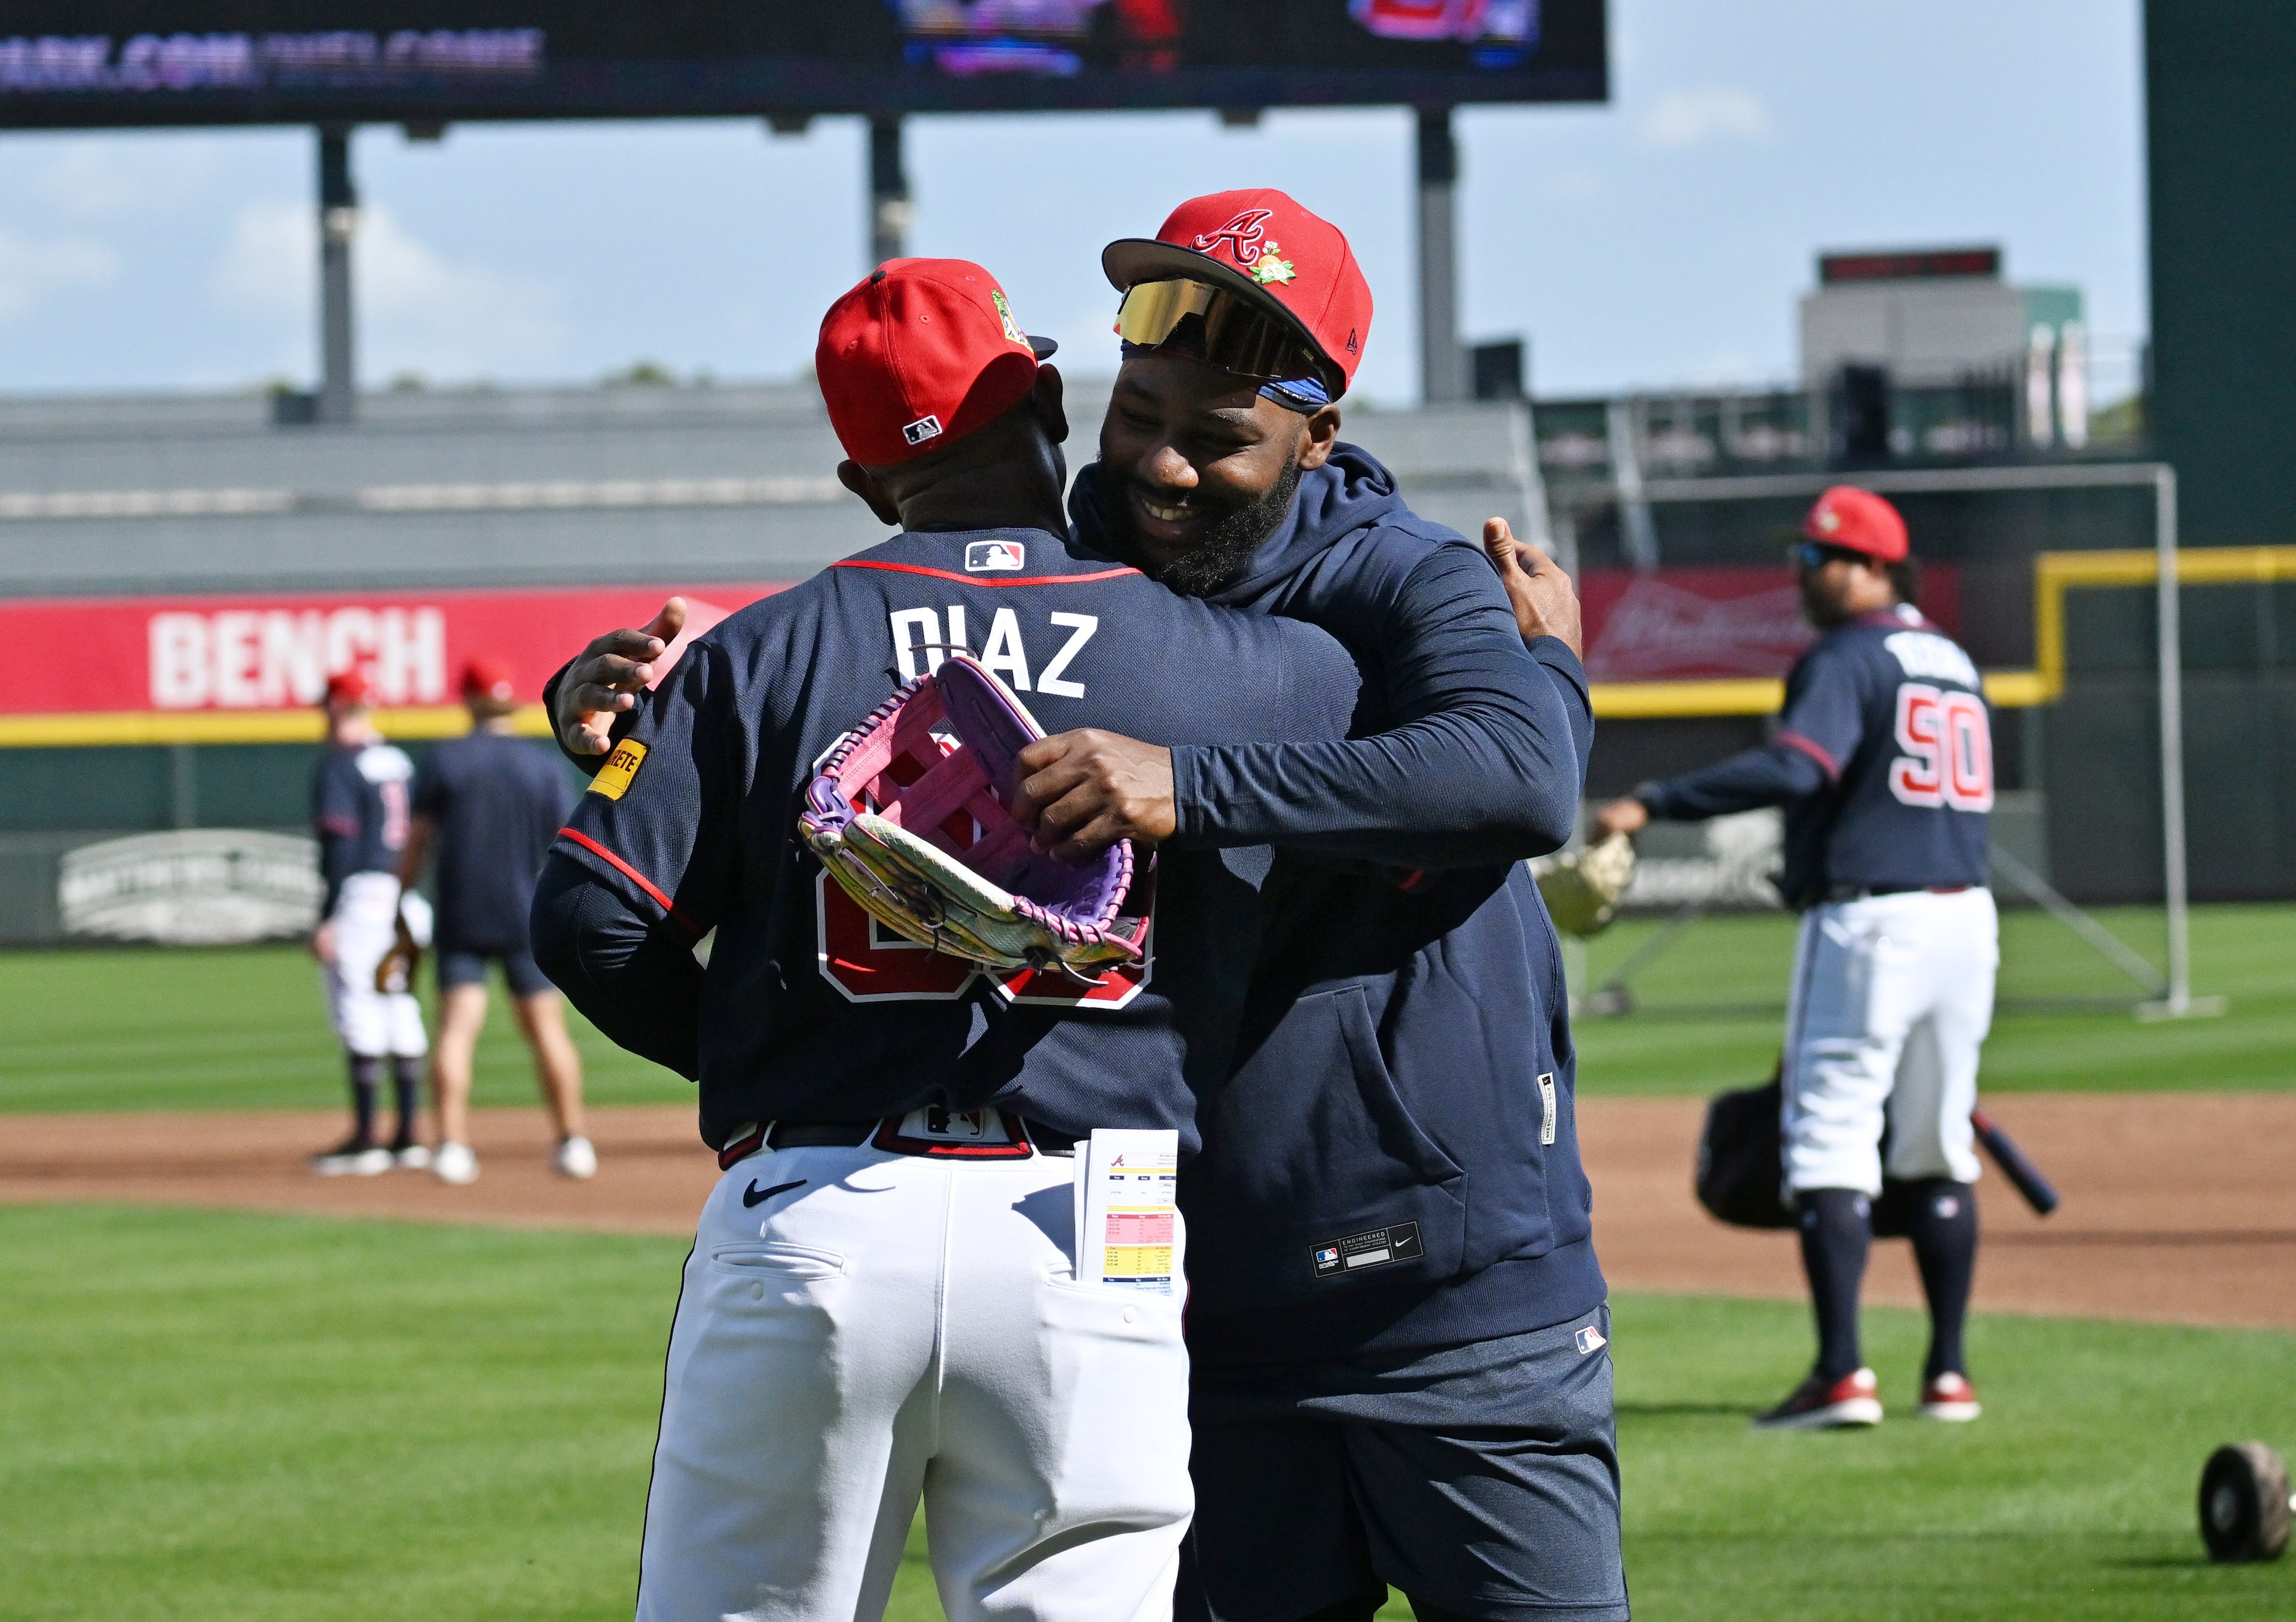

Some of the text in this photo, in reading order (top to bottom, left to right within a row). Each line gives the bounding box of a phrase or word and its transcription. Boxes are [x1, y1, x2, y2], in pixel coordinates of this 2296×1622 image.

[148, 606, 447, 708] BENCH
[890, 605, 1098, 698] DIAZ
[606, 749, 638, 772] RETE
[1888, 682, 1995, 813] 50
[1342, 1232, 1385, 1245] ENGINEERED
